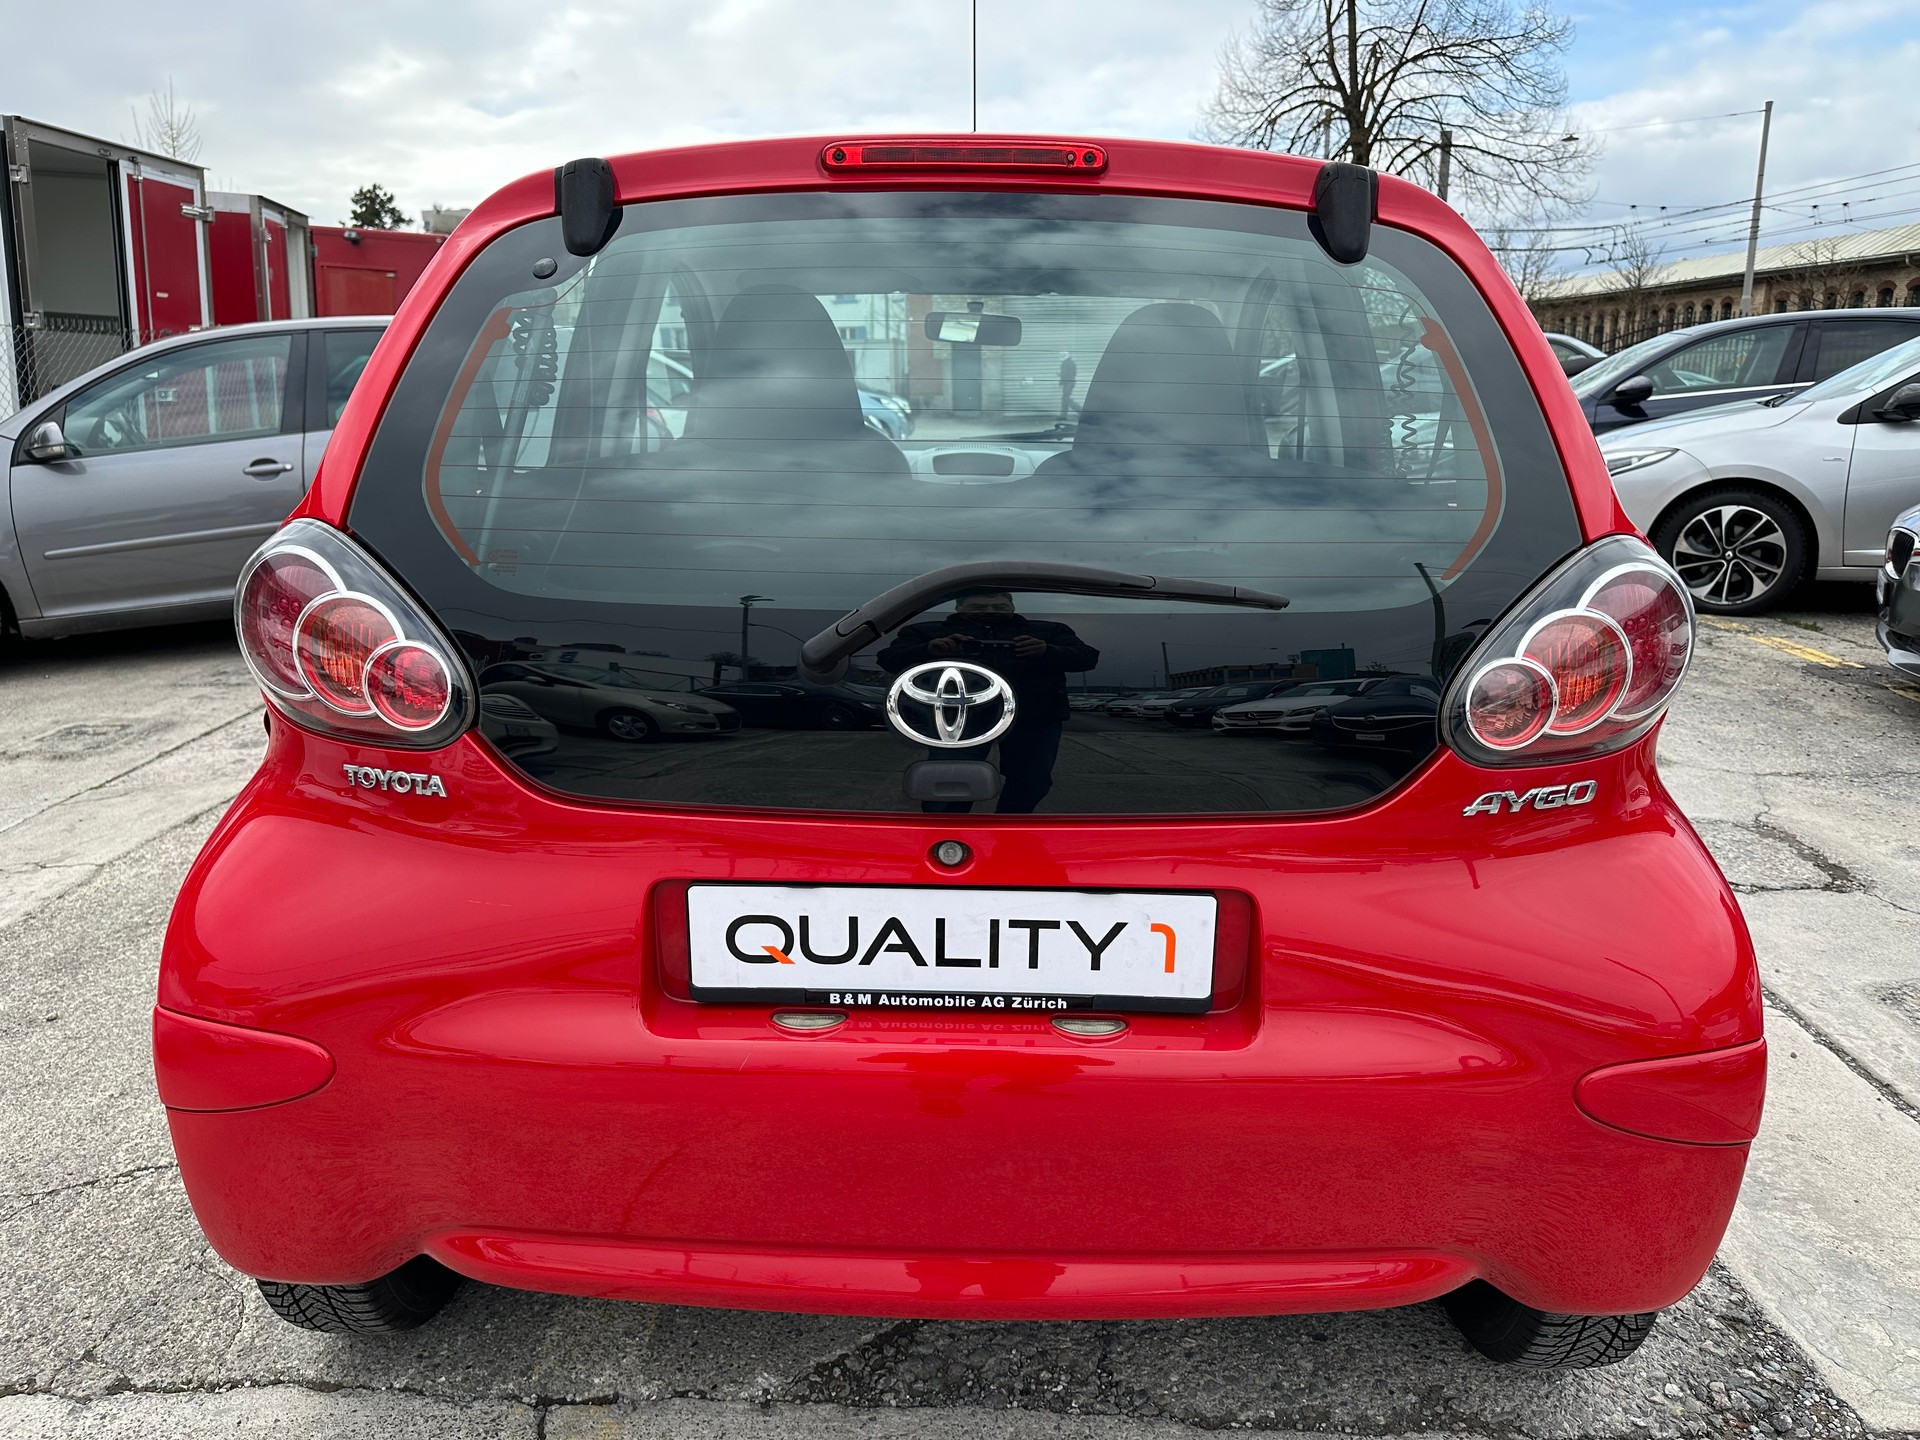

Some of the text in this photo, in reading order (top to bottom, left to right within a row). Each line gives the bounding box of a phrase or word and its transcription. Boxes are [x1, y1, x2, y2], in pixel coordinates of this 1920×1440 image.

[343, 764, 447, 797] TOYOTA
[1462, 780, 1598, 816] AYGO
[725, 914, 1177, 974] QUALITY 1
[829, 993, 1067, 1009] B & M Automobile AG Zürich
